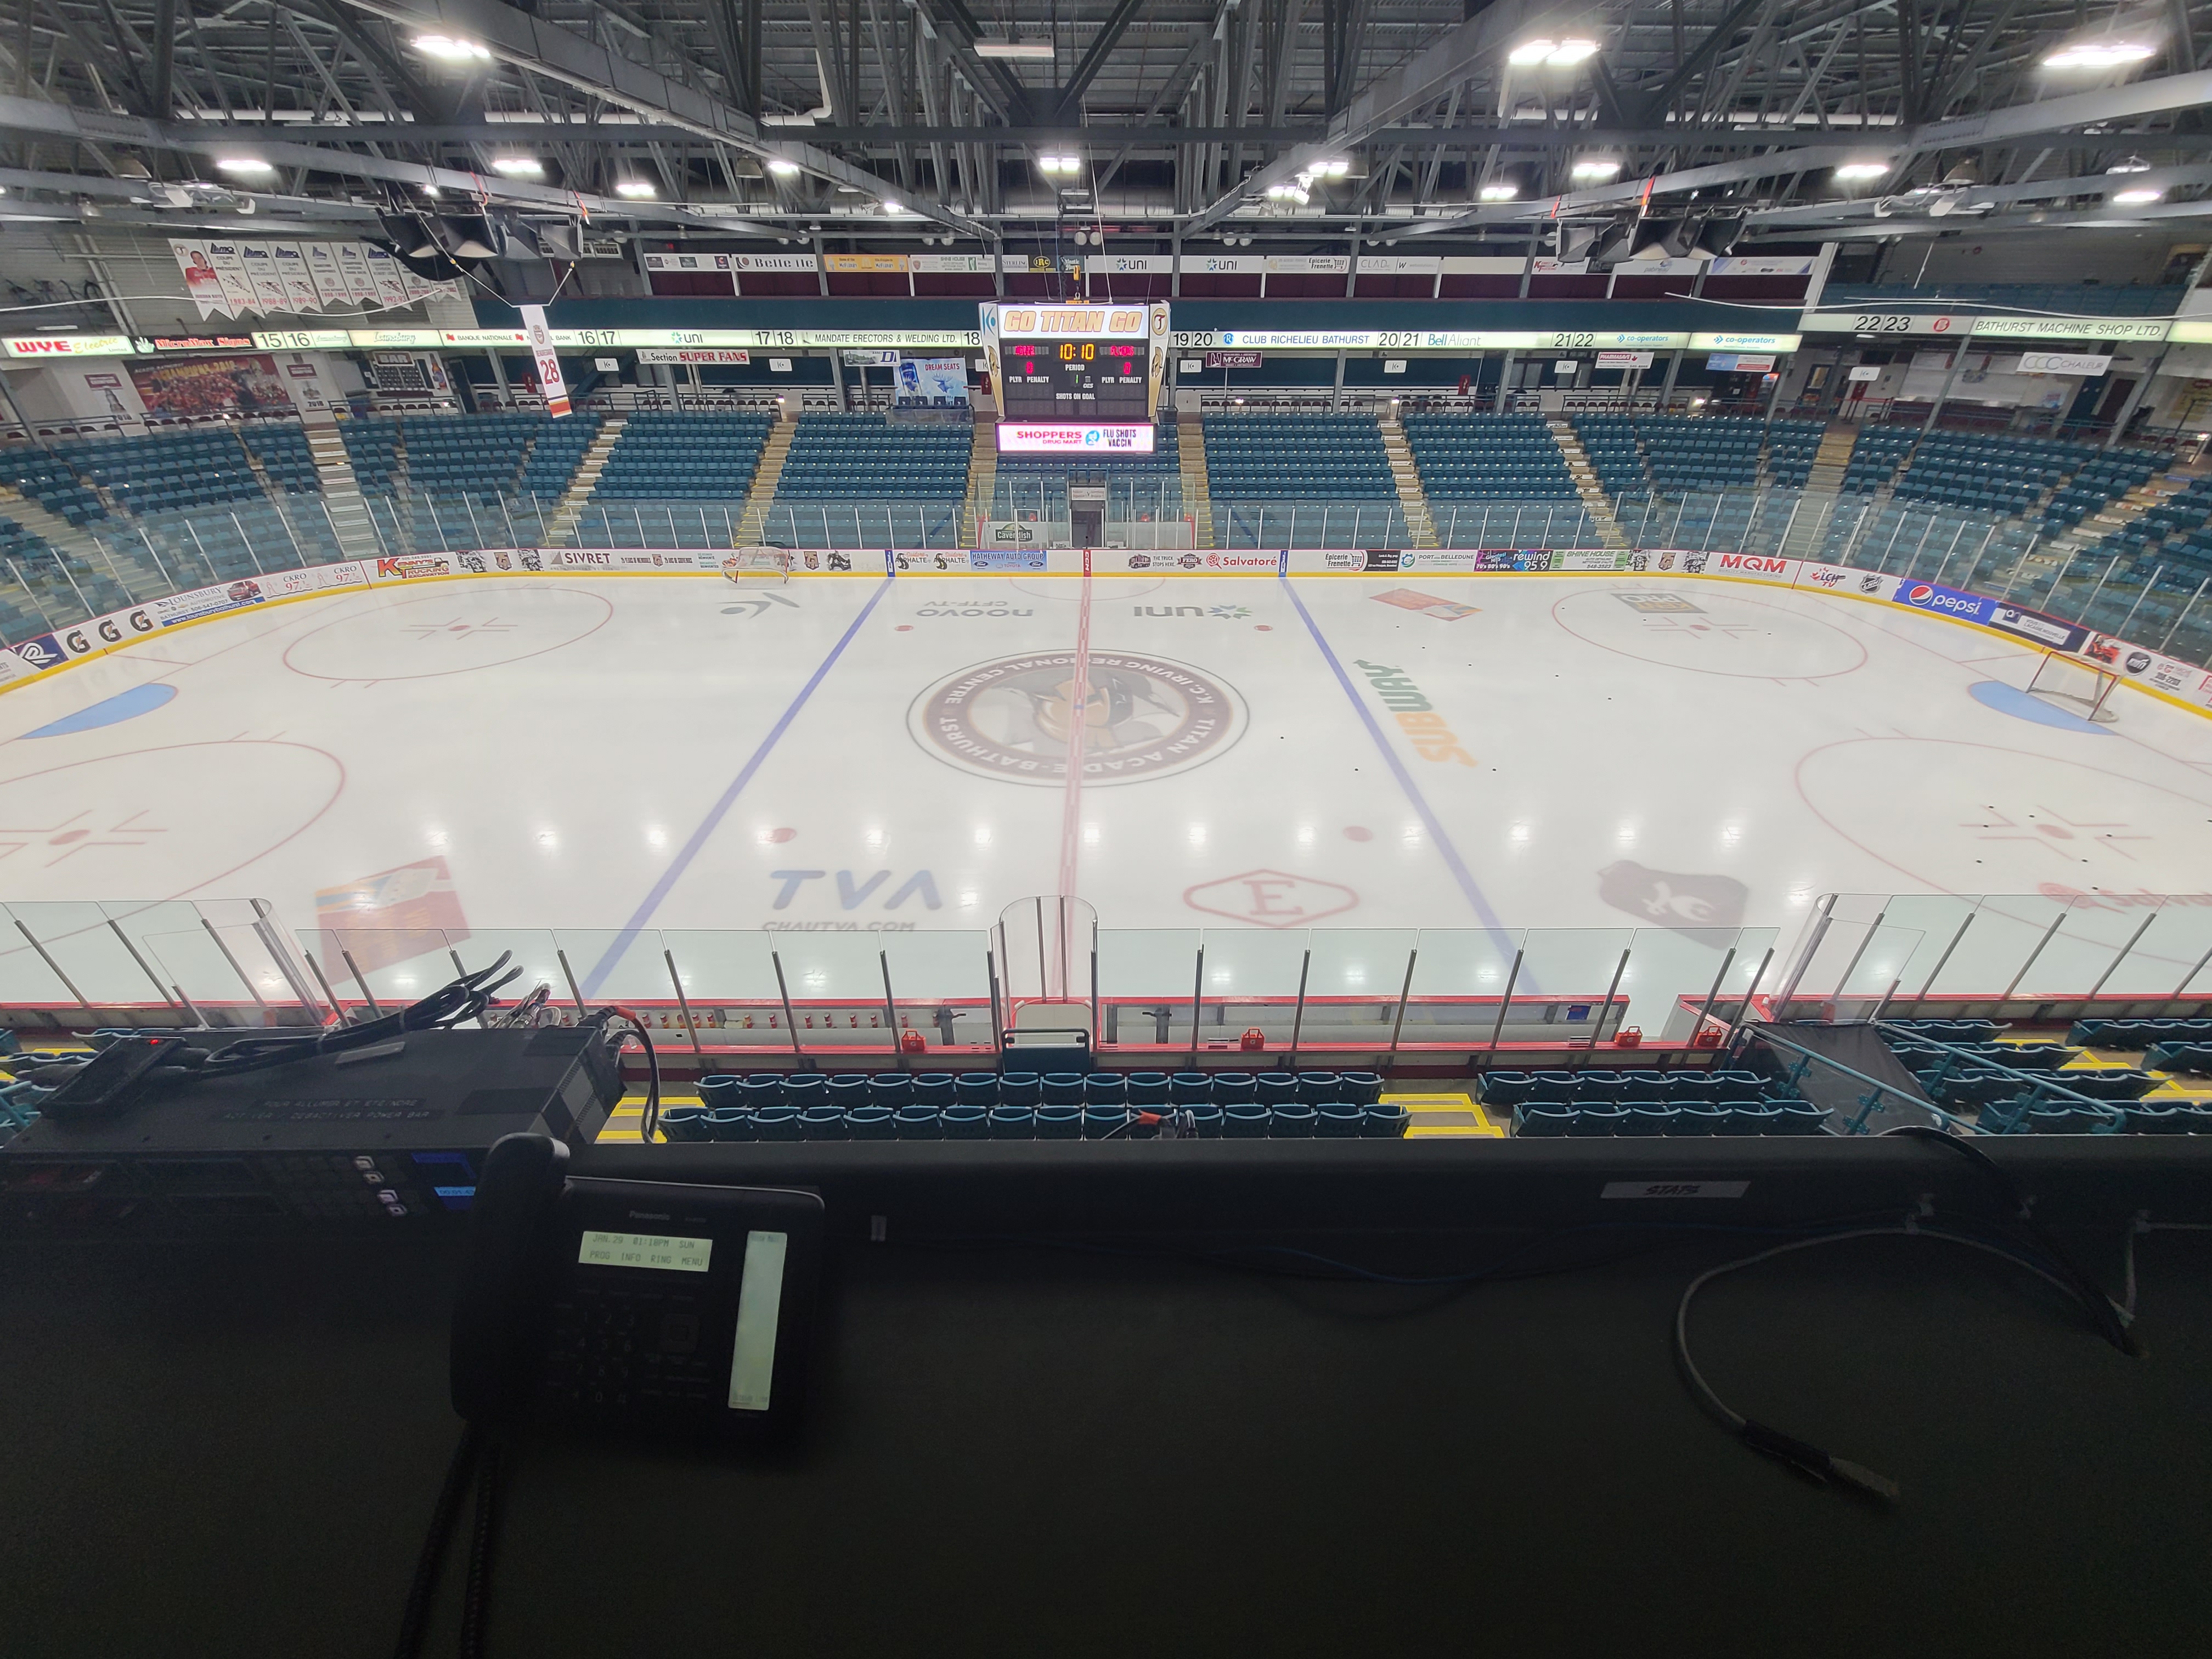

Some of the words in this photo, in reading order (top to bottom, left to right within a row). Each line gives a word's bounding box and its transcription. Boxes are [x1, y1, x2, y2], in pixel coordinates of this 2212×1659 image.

[754, 258, 792, 268] Belle
[1004, 311, 1037, 332] GO
[1041, 311, 1105, 332] TITAN
[1109, 311, 1143, 333] GO
[1854, 315, 1882, 331] 22
[1883, 316, 1911, 332] 23
[1975, 320, 2035, 333] BATHURST
[2036, 322, 2093, 334] MACHINE
[2096, 323, 2133, 335] SHOP
[2135, 325, 2162, 337] LTD.
[258, 333, 283, 348] 15
[287, 332, 311, 347] 16
[578, 331, 595, 345] 16
[600, 331, 616, 345] 17
[755, 331, 770, 345] 17
[776, 331, 794, 345] 18
[815, 334, 850, 343] MANDATE
[853, 334, 893, 343] ERECTORS
[896, 334, 902, 343] &
[905, 334, 939, 343] WELDING
[941, 334, 957, 343] LTD.
[963, 331, 981, 345] 18
[1172, 333, 1189, 346] 19
[1194, 332, 1212, 346] 20
[1243, 335, 1267, 344] CLUB
[1271, 335, 1319, 344] RICHELIEU
[1322, 335, 1370, 344] BATHURST
[1378, 333, 1398, 346] 20
[1402, 333, 1420, 347] 21
[1428, 334, 1447, 347] Bell
[1449, 334, 1482, 347] Aliant
[1554, 334, 1571, 347] 21
[1575, 334, 1594, 347] 22
[1627, 334, 1669, 343] co-operators
[1725, 336, 1775, 345] co-operators
[14, 340, 72, 353] WYE
[73, 337, 119, 354] Electric
[1059, 343, 1095, 360] 10:10
[380, 354, 409, 363] BAR
[651, 352, 678, 362] Section
[679, 352, 714, 362] SUPER
[719, 352, 747, 362] FANS
[2062, 359, 2104, 369] CHALEUR
[540, 359, 560, 385] 28
[925, 363, 943, 371] DREAM
[944, 363, 960, 371] SEATS
[1017, 431, 1082, 439] SHOPPERS
[1103, 429, 1115, 438] FLU
[1116, 429, 1137, 438] SHOTS
[1108, 438, 1132, 448] VACCIN
[565, 552, 611, 565] SIVRET
[1222, 555, 1277, 567] Salvatoré
[1325, 552, 1348, 561] Épicerie
[1513, 550, 1551, 561] rewind
[1720, 554, 1787, 574] MQM
[283, 572, 307, 583] CKRO
[334, 565, 357, 576] CKRO
[408, 571, 450, 579] EXCAVATION
[1740, 570, 1782, 579] MANUFACTURING
[1821, 580, 1836, 588] TV
[168, 586, 223, 605] LOUNSBURY
[190, 594, 226, 606] AUTOMOTIVE
[1620, 594, 1681, 604] PRO
[1931, 592, 1983, 616] pepsi
[129, 610, 154, 633] G
[160, 609, 189, 620] BATHURST
[99, 619, 123, 643] G
[66, 629, 92, 654] G
[1013, 657, 1122, 671] REIONAL
[1126, 661, 1183, 687] IRVING
[945, 668, 1006, 704] CENTRE
[1185, 682, 1215, 704] K.C.
[1353, 659, 1480, 768] SUBWAY
[1172, 718, 1215, 754] TITAN
[770, 869, 943, 911] TVA
[1243, 879, 1304, 916] E
[407, 1110, 430, 1119] BAR
[629, 1210, 670, 1221] Panasonic
[678, 1240, 695, 1249] SUN
[589, 1250, 610, 1260] PROG
[620, 1253, 641, 1262] INFO
[650, 1255, 672, 1265] RING
[681, 1256, 703, 1267] MENU
